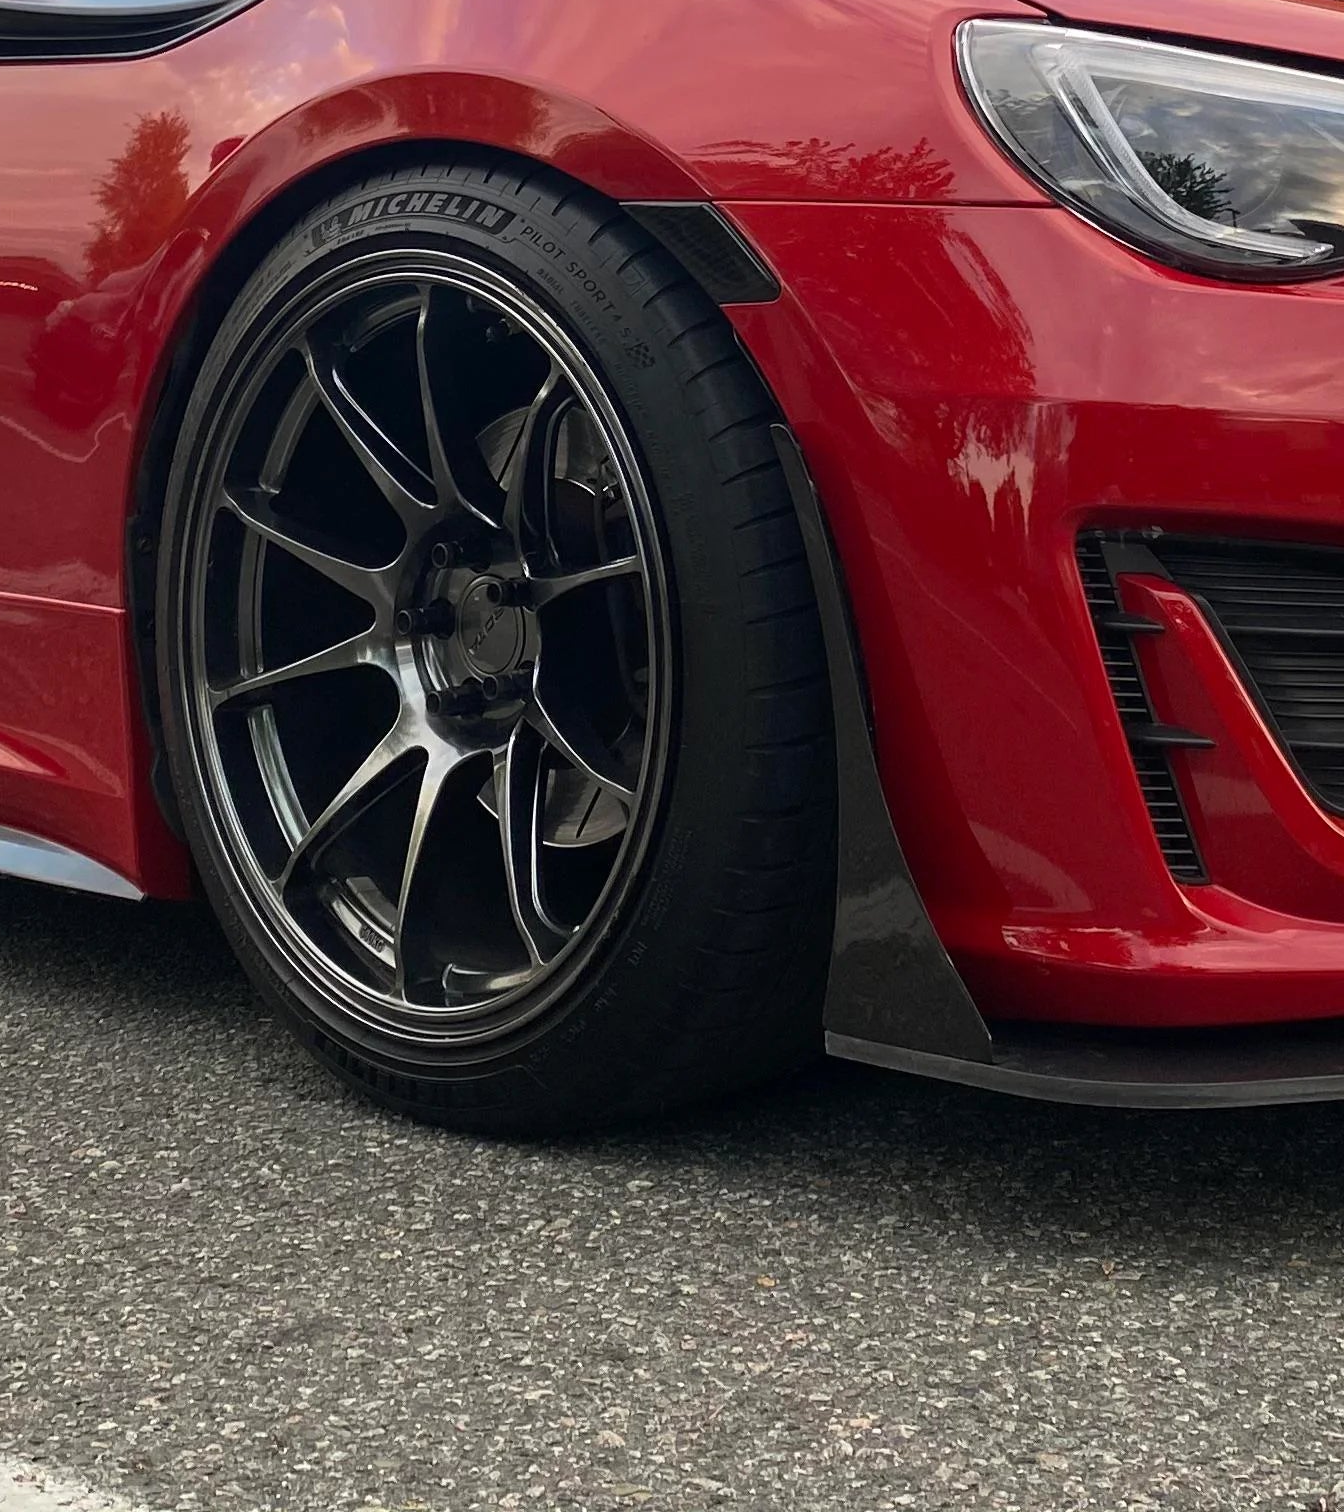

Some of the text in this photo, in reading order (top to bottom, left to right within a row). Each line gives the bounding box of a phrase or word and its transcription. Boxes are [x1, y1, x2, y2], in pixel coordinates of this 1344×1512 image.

[347, 192, 506, 228] MICHELIN
[520, 226, 566, 259] PILOT
[566, 262, 615, 312] SPORT
